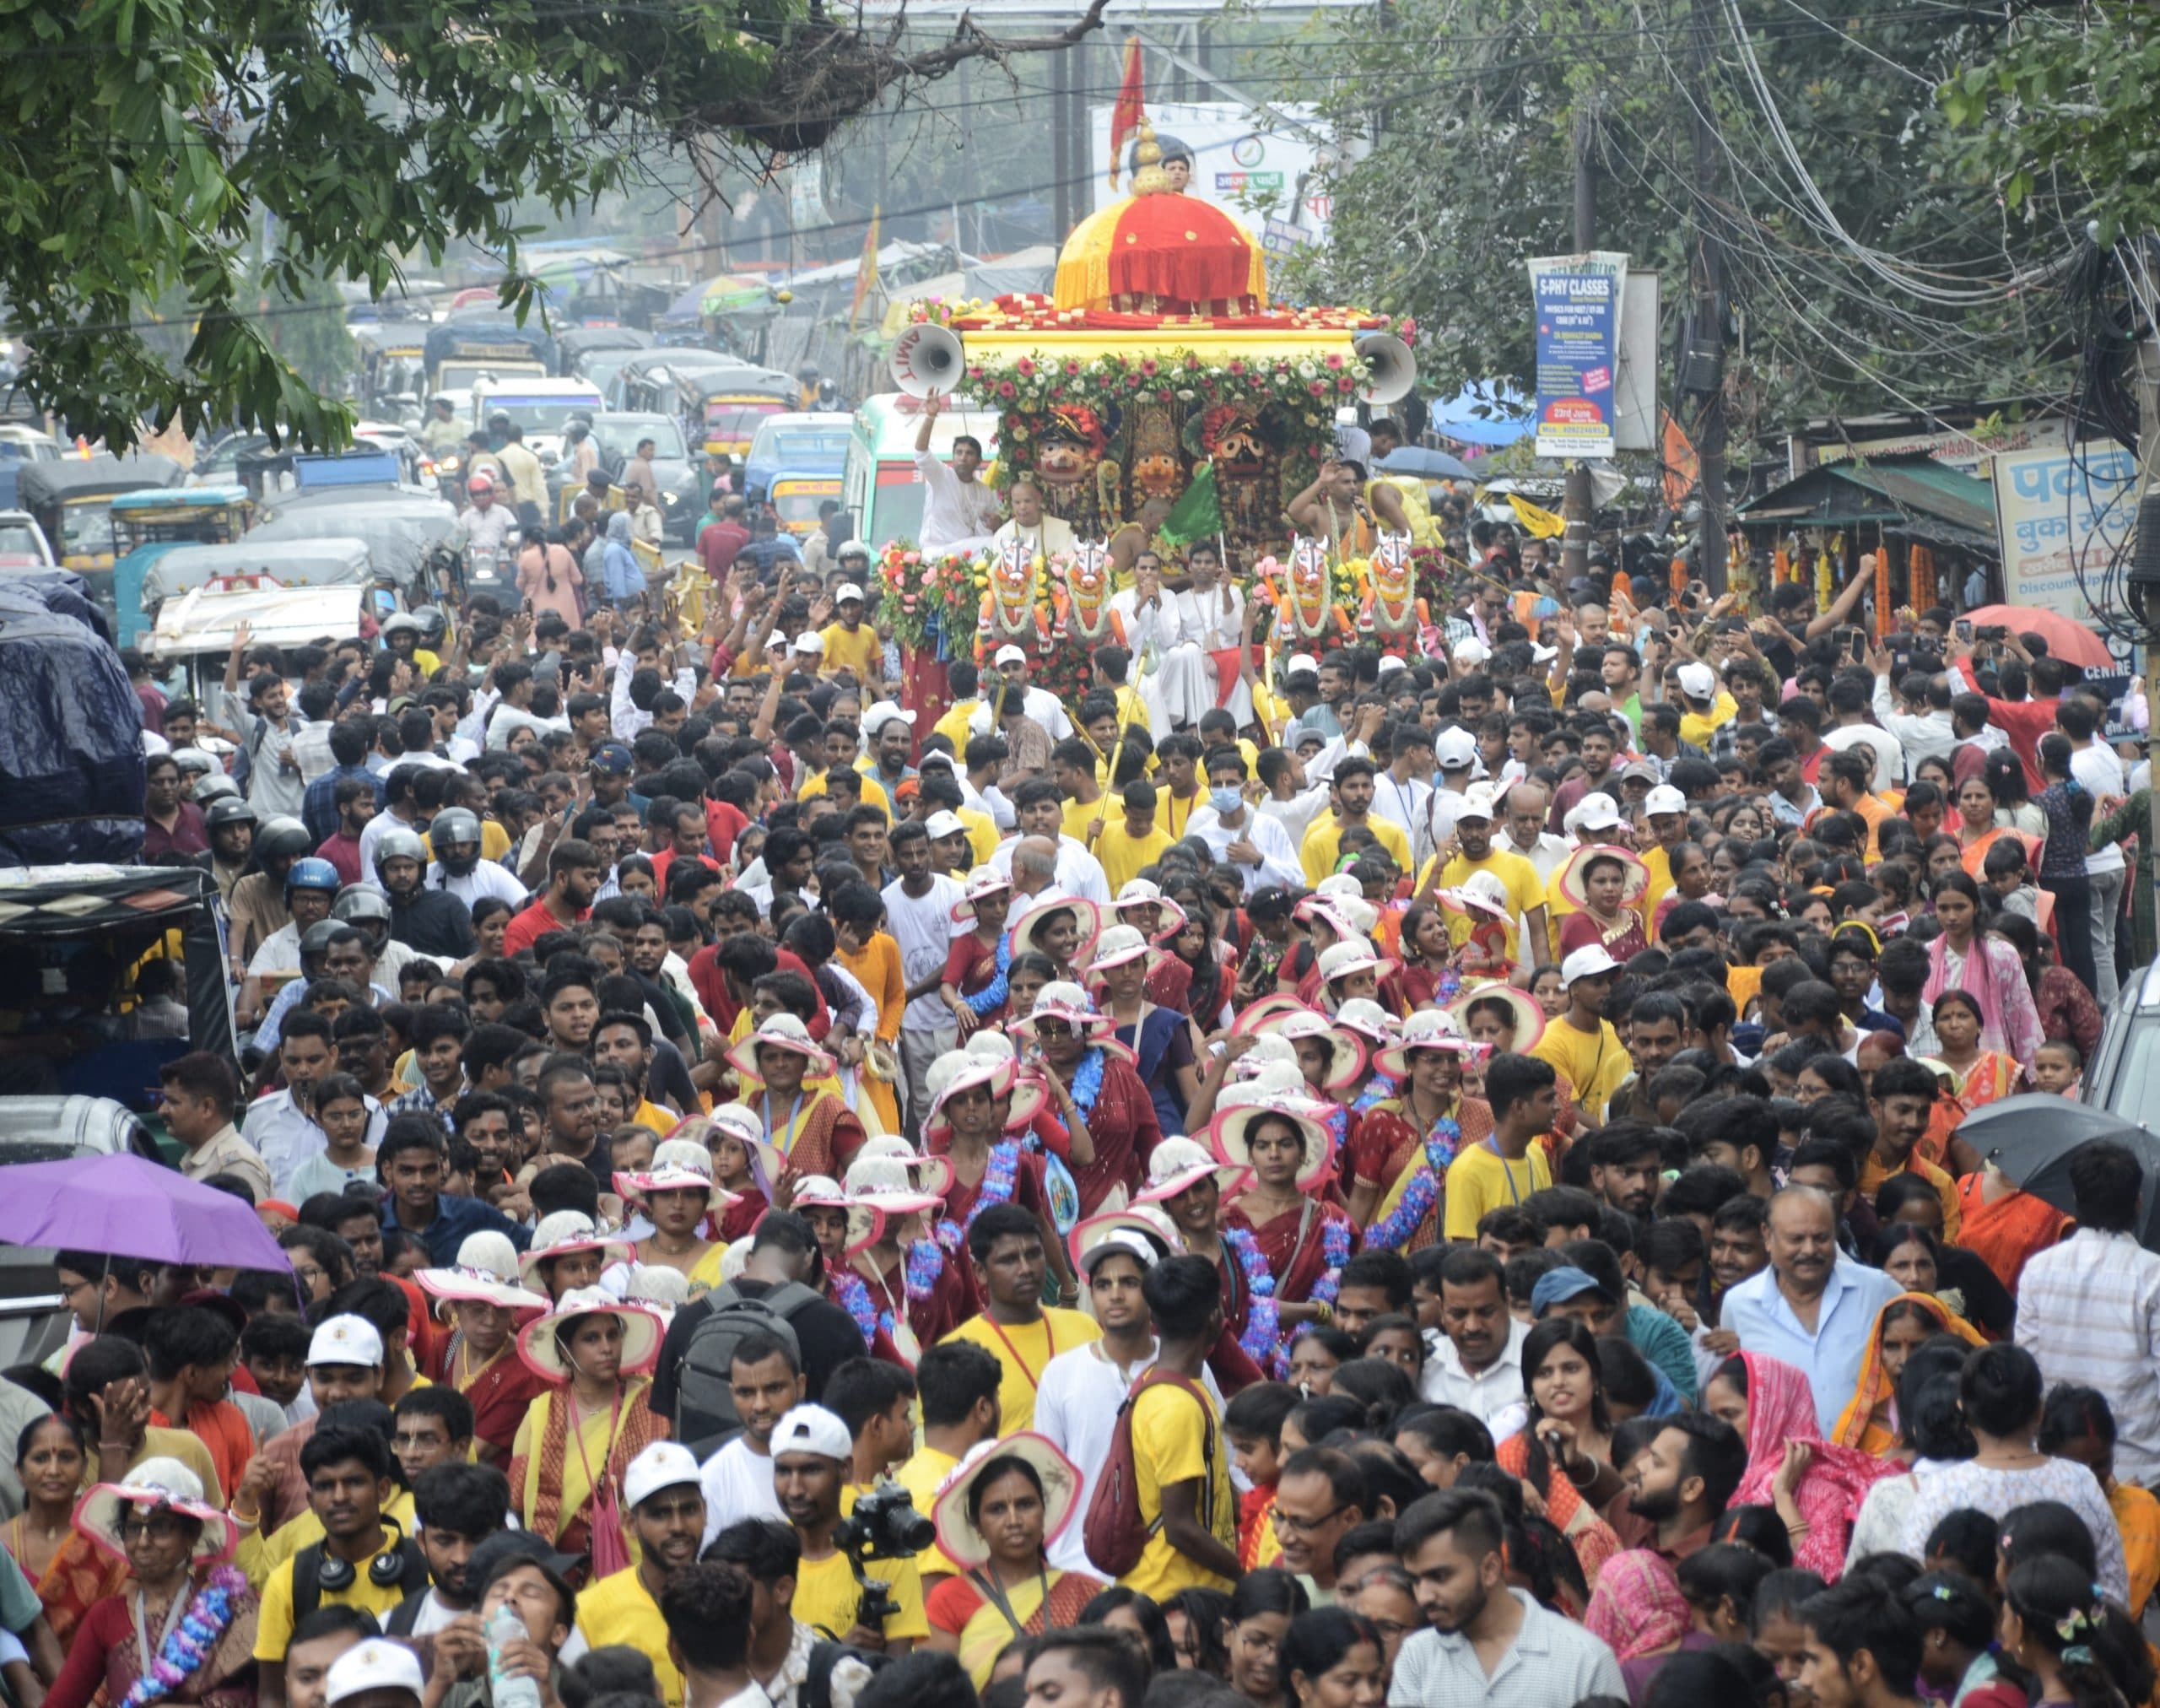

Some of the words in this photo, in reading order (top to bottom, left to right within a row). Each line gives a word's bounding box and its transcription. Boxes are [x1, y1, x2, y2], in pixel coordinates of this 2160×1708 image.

[1540, 278, 1568, 296] S-PHY
[1569, 278, 1609, 296] CLASSES
[895, 330, 921, 380] AMIT
[1554, 408, 1571, 419] 23rd
[1929, 439, 1972, 458] CHAAT
[1975, 430, 2030, 452] CENRE
[2010, 451, 2136, 503] पवन
[2015, 516, 2068, 553] बुक
[2018, 576, 2079, 595] Discount
[2085, 660, 2131, 680] CENTRE
